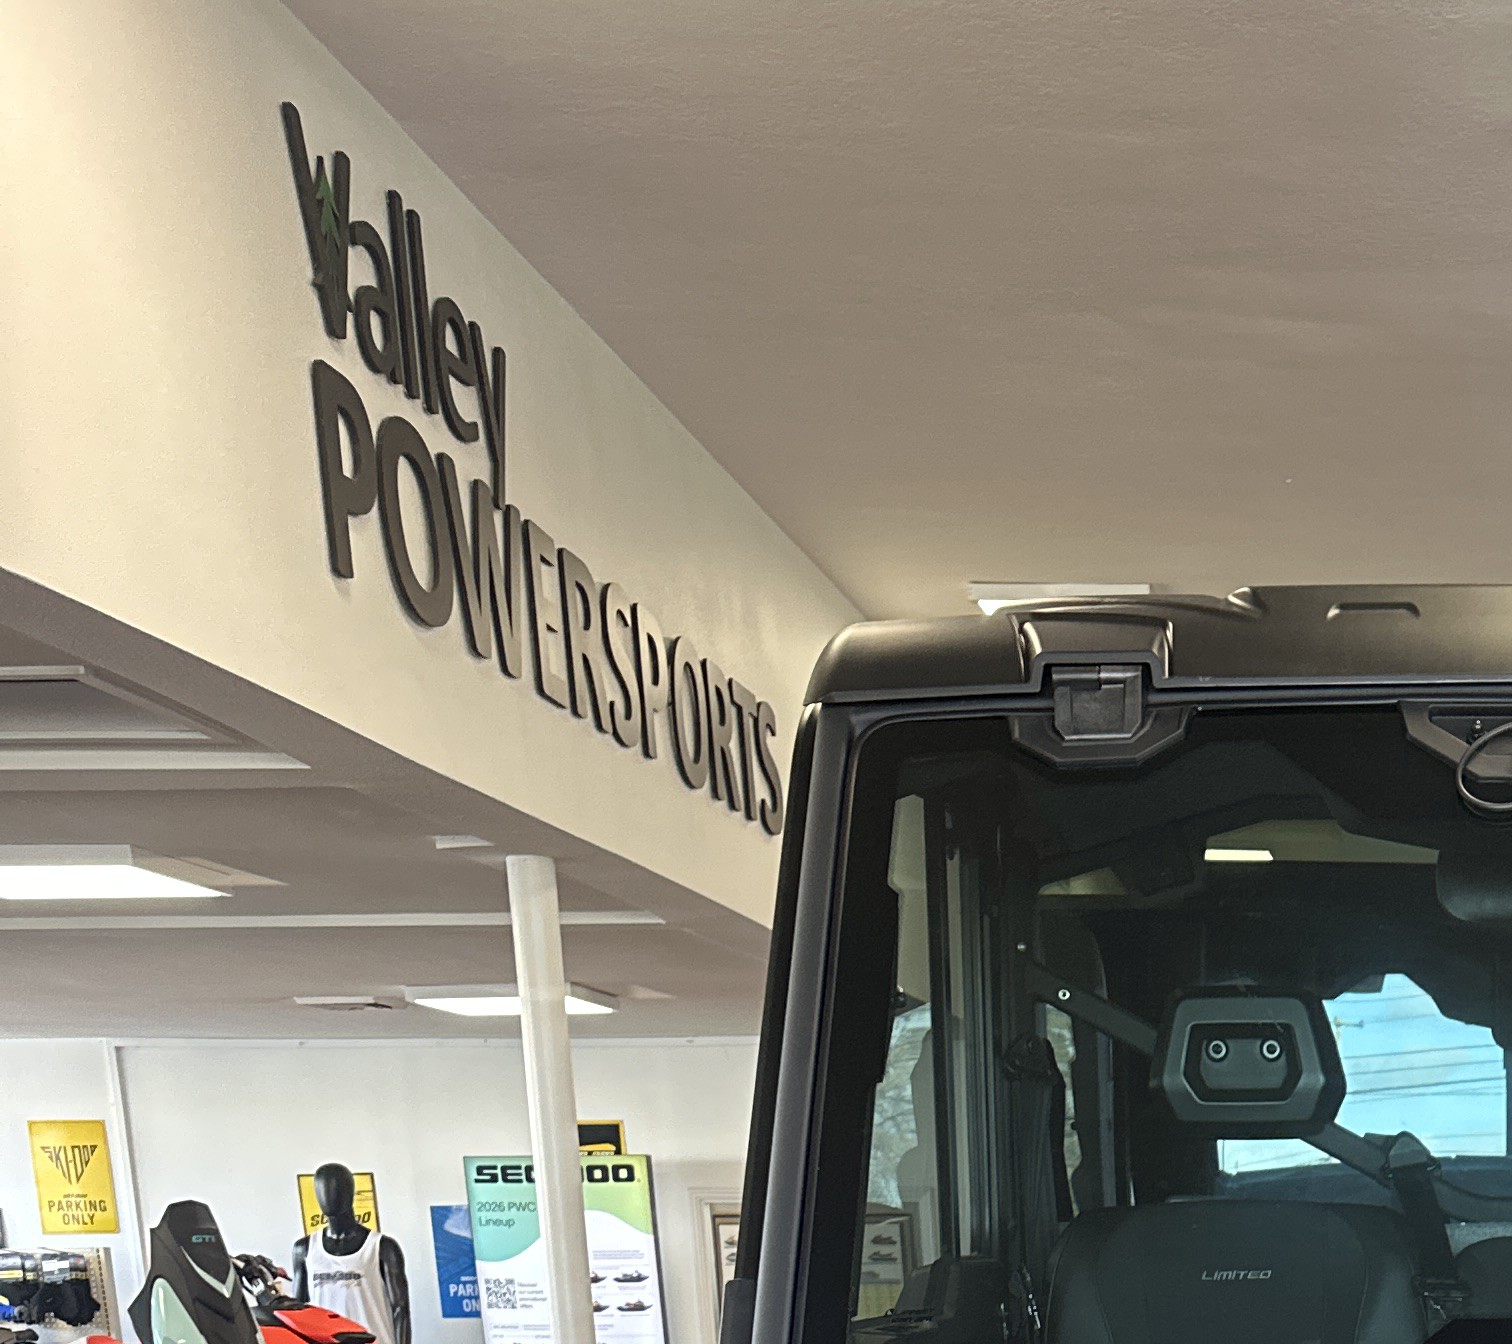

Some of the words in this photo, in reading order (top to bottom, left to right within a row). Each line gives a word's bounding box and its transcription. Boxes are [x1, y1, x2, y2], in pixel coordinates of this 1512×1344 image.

[281, 101, 506, 511] Valley
[312, 358, 784, 836] POWERSPORTS
[40, 1145, 98, 1185] SKI-DOO
[48, 1199, 107, 1212] PARKING
[476, 1201, 506, 1212] 2026
[507, 1201, 537, 1212] PWC
[62, 1213, 95, 1225] ONLY
[479, 1216, 516, 1229] Lineup
[1201, 1269, 1272, 1280] LIMITED
